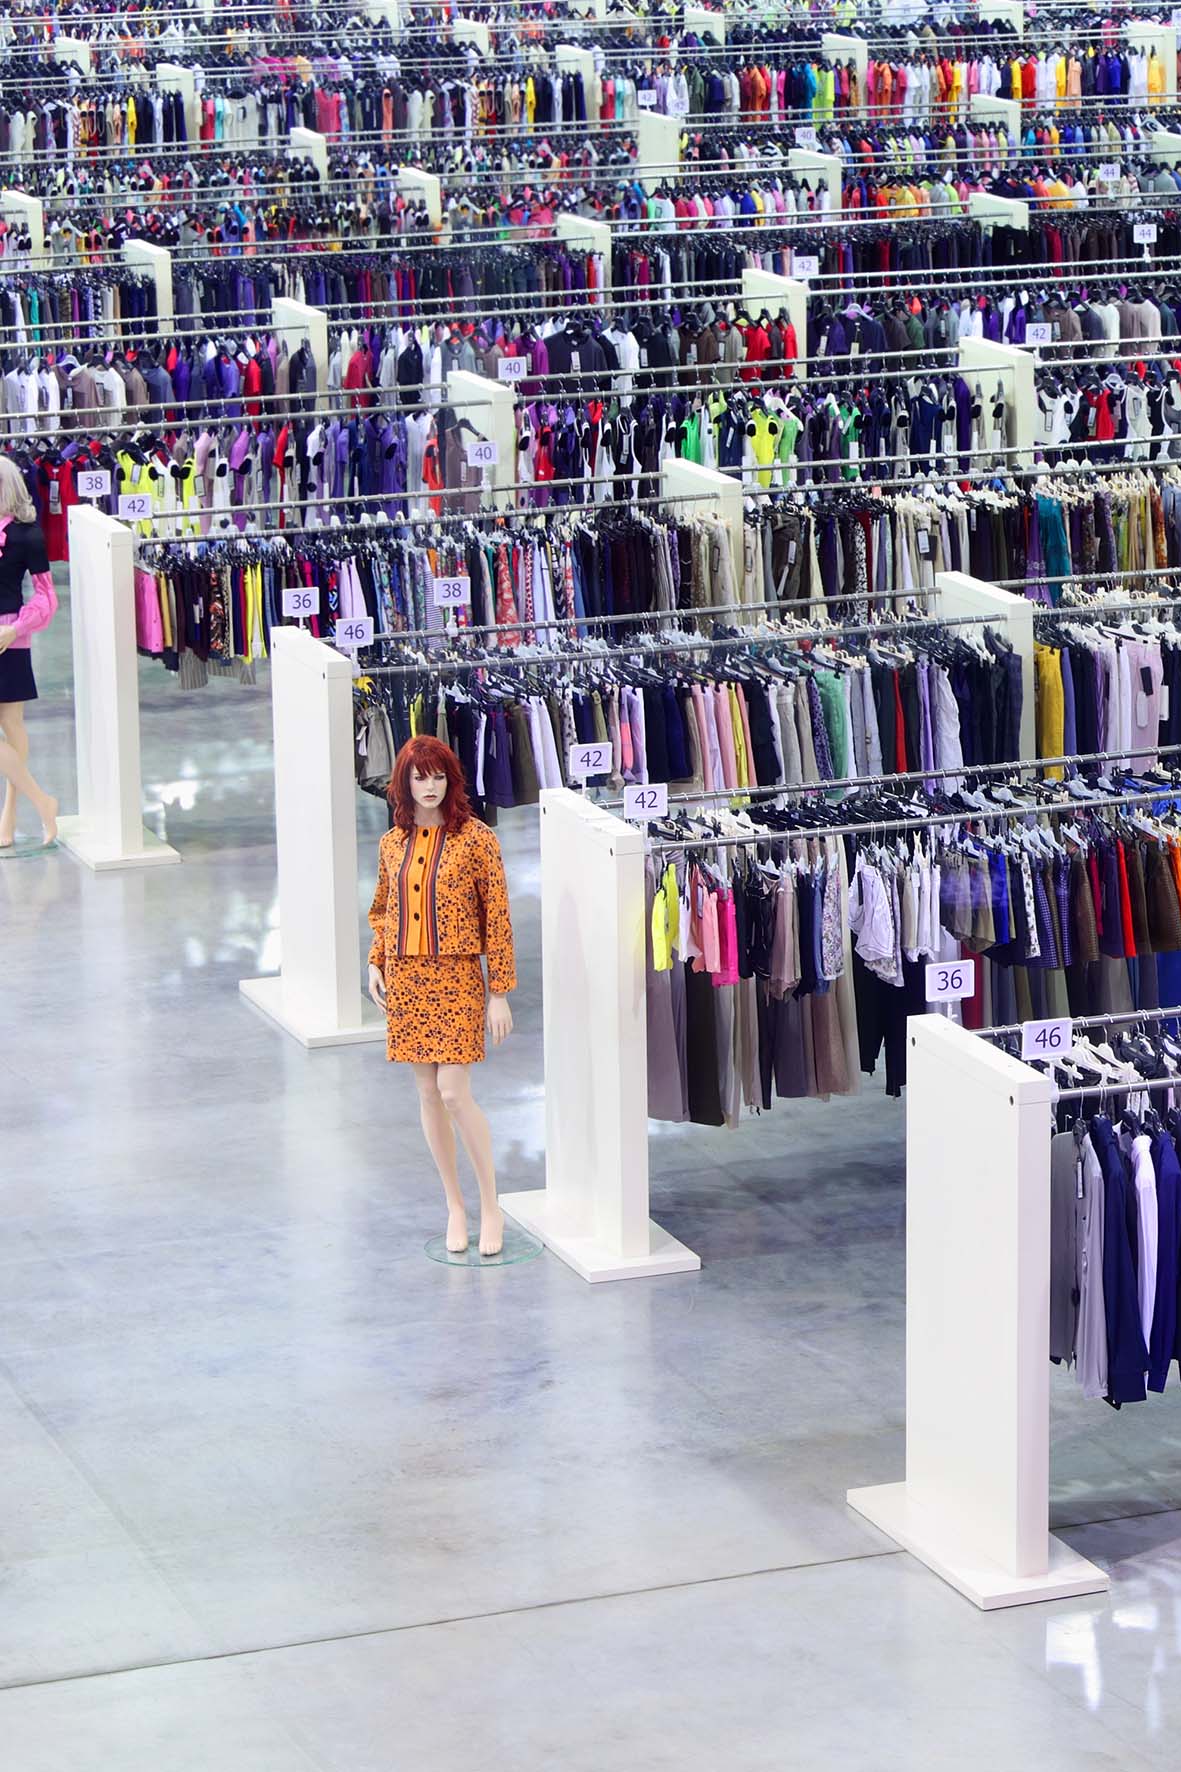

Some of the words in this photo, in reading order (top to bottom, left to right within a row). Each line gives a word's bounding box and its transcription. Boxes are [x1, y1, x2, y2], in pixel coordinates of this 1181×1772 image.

[800, 130, 812, 139] 40
[1103, 167, 1115, 177] 44
[1139, 229, 1152, 239] 44
[798, 260, 812, 271] 42
[1031, 327, 1046, 339] 42
[505, 361, 520, 374] 40
[475, 446, 492, 460] 40
[86, 476, 103, 490] 38
[127, 499, 145, 512] 42
[442, 583, 462, 598] 38
[292, 593, 311, 609] 36
[344, 624, 364, 639] 46
[580, 750, 602, 768] 42
[634, 790, 658, 809] 42
[937, 969, 963, 991] 36
[1035, 1026, 1061, 1049] 46
